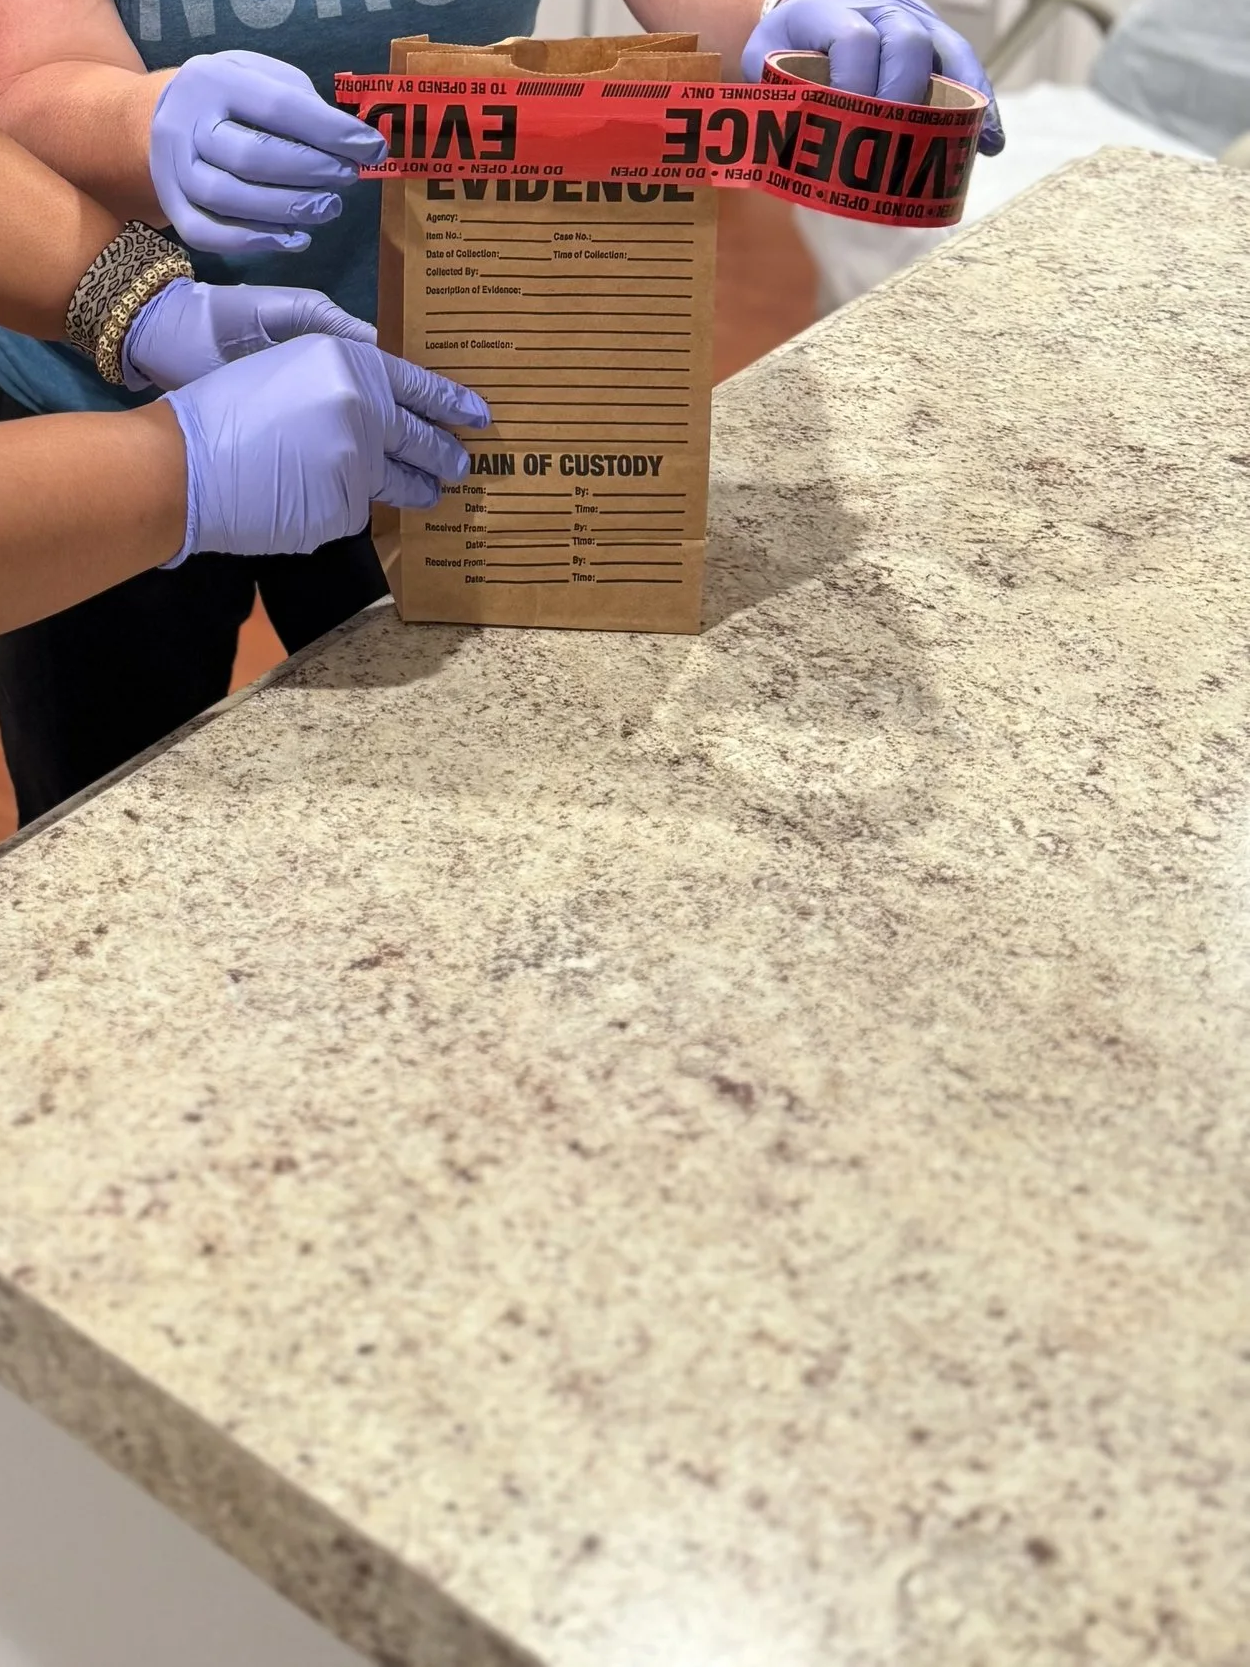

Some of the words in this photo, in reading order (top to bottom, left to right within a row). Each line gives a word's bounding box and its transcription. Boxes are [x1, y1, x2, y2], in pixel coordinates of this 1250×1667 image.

[398, 80, 414, 93] BY
[418, 80, 467, 94] OPENED
[470, 81, 486, 94] BE
[490, 82, 507, 95] TO
[680, 86, 715, 99] ONLY
[719, 87, 796, 101] PERSONNEL
[801, 90, 883, 118] AUTHORIZED
[885, 106, 905, 121] BY
[908, 109, 954, 126] OPENED
[340, 102, 517, 161] EVID
[662, 107, 972, 199] EVIDENCE
[402, 162, 429, 173] NOT
[433, 163, 453, 173] DO
[470, 163, 507, 174] OPEN
[511, 164, 540, 175] NOT
[543, 165, 563, 175] DO
[610, 166, 648, 177] OPEN
[650, 167, 682, 178] NOT
[685, 168, 706, 178] DO
[724, 168, 762, 182] OPEN
[766, 172, 793, 191] NOT
[792, 180, 812, 198] DO
[829, 190, 870, 210] OPEN
[873, 201, 903, 216] NOT
[905, 204, 924, 218] DO
[425, 213, 458, 223] Agency:
[425, 232, 444, 240] Item
[553, 233, 573, 241] Case
[426, 250, 444, 259] Date
[446, 249, 454, 258] of
[456, 249, 500, 258] Collection:
[553, 250, 572, 259] Time
[574, 250, 582, 259] of
[584, 250, 628, 259] Collection:
[425, 267, 463, 277] Collected
[465, 267, 479, 277] By:
[425, 286, 470, 296] Description
[471, 286, 480, 295] of
[482, 286, 521, 295] Evidence:
[425, 340, 459, 349] Location
[460, 340, 469, 349] of
[470, 340, 514, 349] Collection:
[469, 453, 515, 476] AIN
[523, 453, 552, 476] OF
[559, 453, 664, 477] CUSTODY
[441, 485, 461, 494] ived
[463, 485, 487, 494] From:
[575, 486, 589, 497] By:
[465, 503, 487, 513] Date:
[575, 504, 598, 514] Time:
[425, 522, 462, 533] Received
[463, 524, 487, 533] From:
[574, 522, 588, 532] By:
[466, 540, 487, 550] Date:
[572, 536, 595, 546] Time:
[425, 557, 462, 567] Received
[463, 558, 486, 567] From:
[572, 555, 586, 566] By:
[465, 575, 486, 584] Date:
[572, 572, 595, 582] Time:
